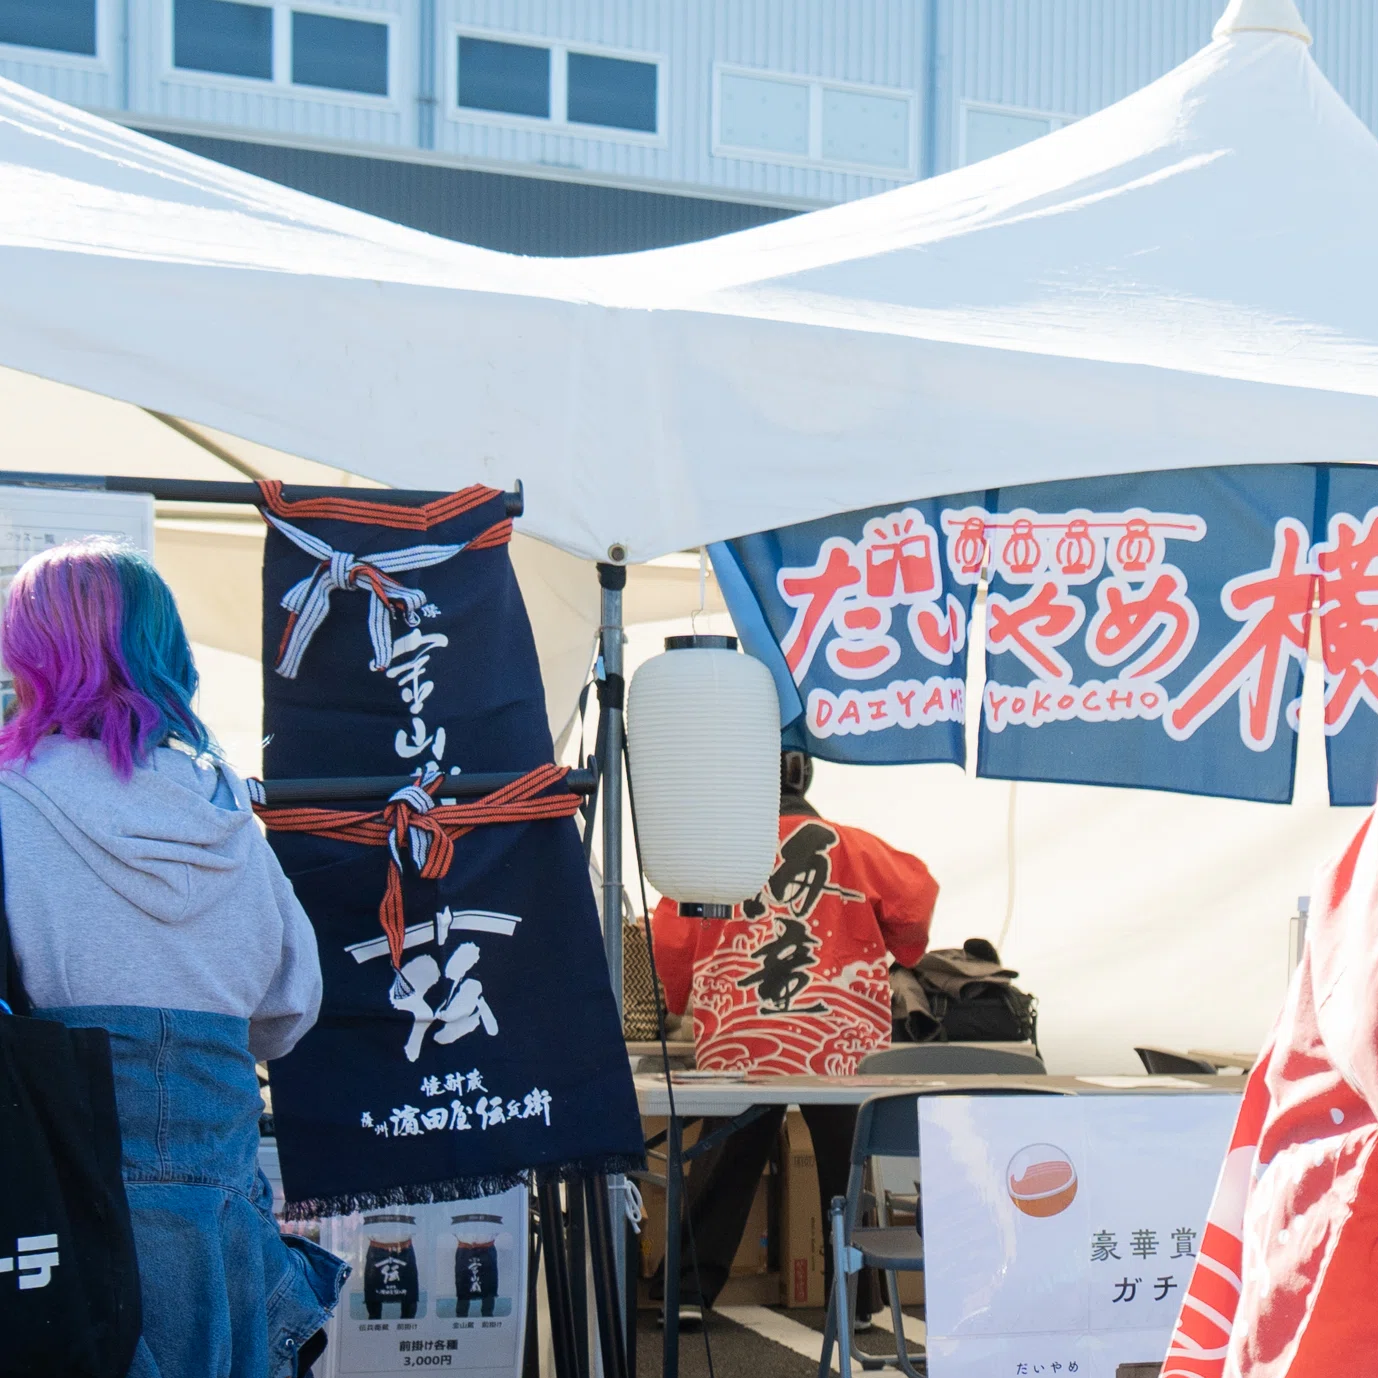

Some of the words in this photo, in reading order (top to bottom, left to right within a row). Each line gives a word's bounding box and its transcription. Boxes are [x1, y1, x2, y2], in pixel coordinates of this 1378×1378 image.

[989, 687, 1160, 722] YOKOCHO
[1090, 1227, 1198, 1263] 豪華賞
[1111, 1275, 1179, 1304] ガチ
[399, 1339, 459, 1352] 前掛け各種
[403, 1355, 452, 1367] 3,000円
[1016, 1361, 1080, 1376] だいやめ
